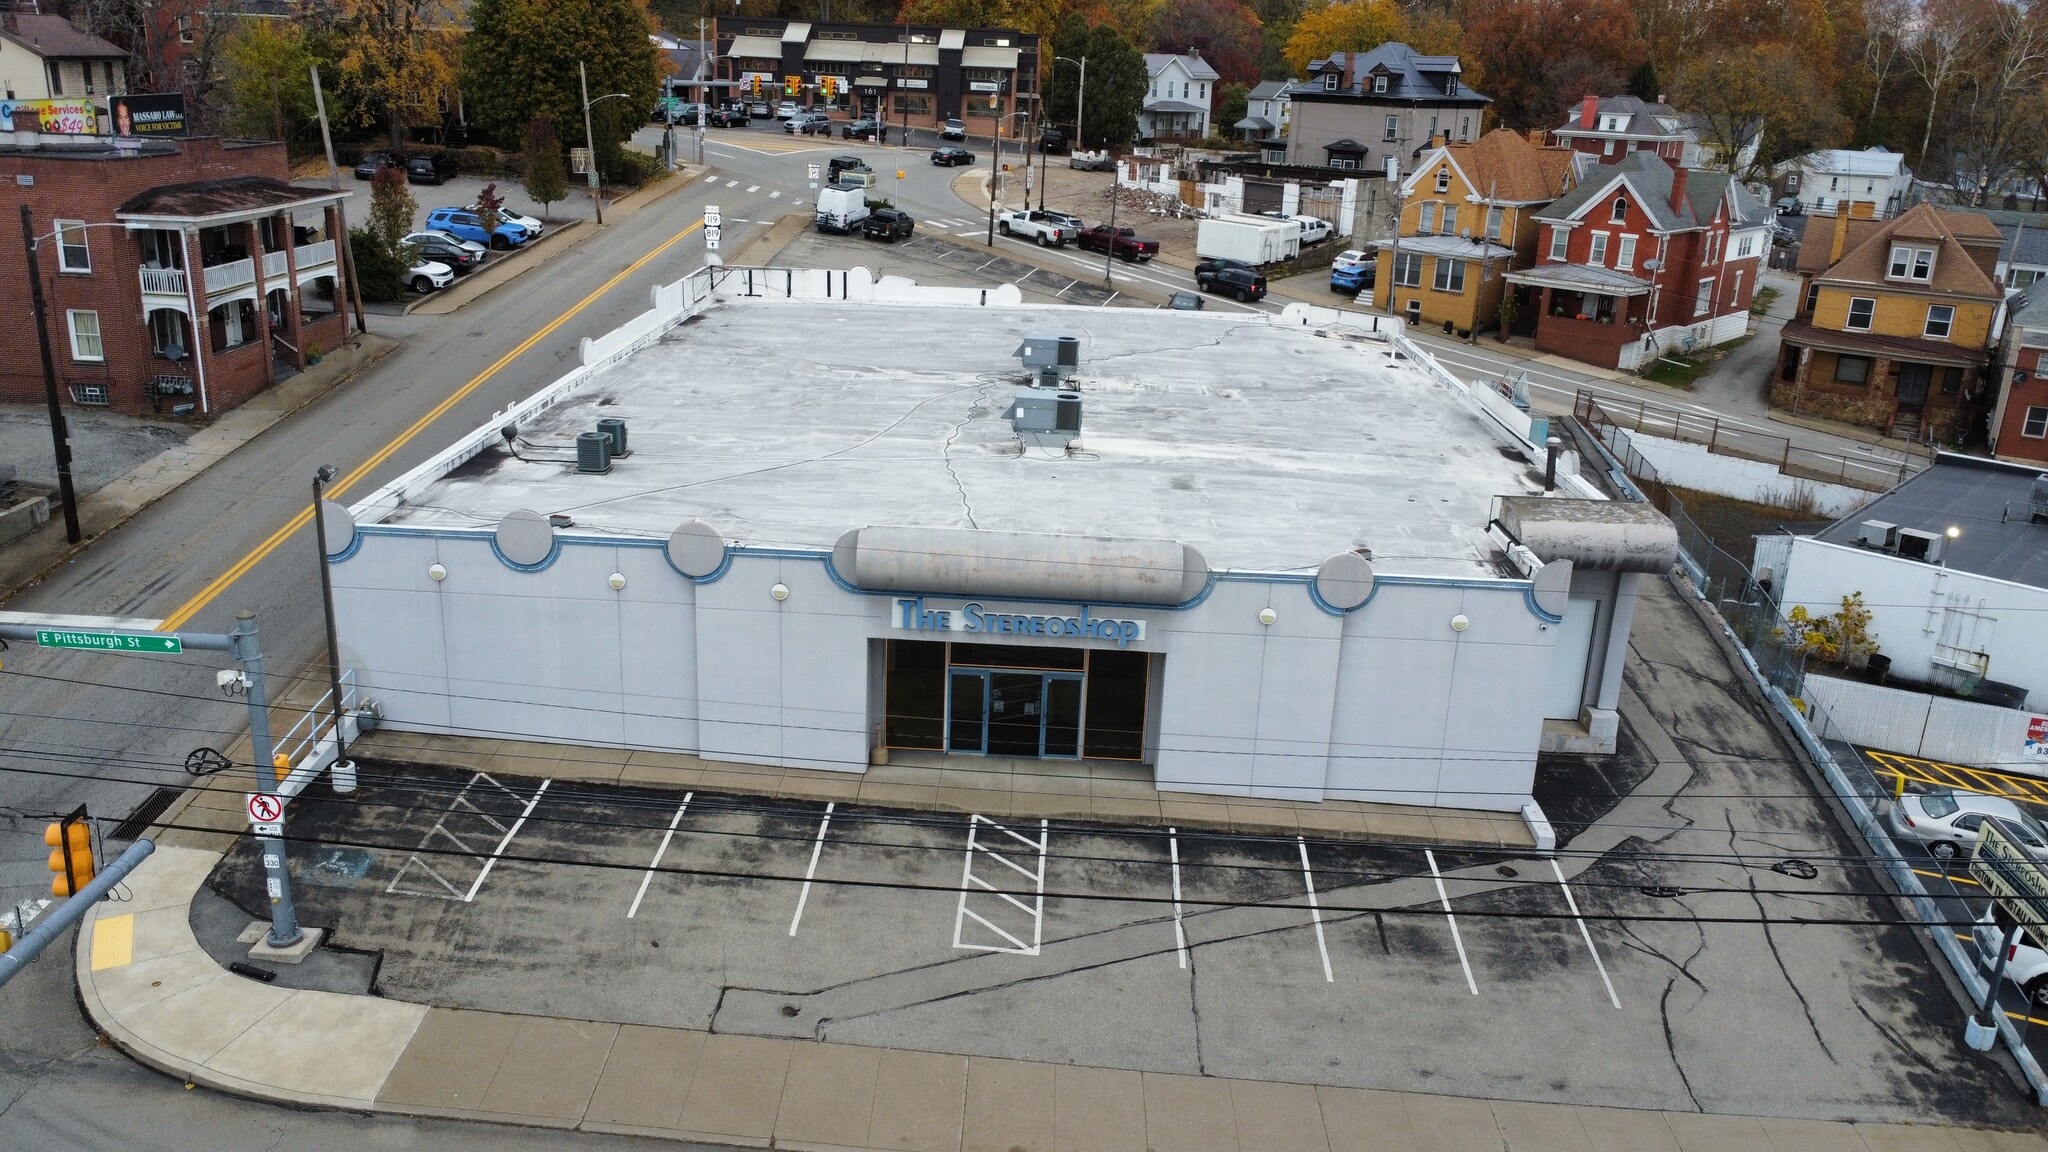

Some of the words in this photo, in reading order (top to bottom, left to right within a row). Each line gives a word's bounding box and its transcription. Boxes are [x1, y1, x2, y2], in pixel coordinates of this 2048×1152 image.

[47, 104, 84, 115] Services
[132, 111, 161, 122] MASSARO
[162, 110, 176, 120] LAW
[58, 117, 84, 133] $49
[135, 124, 152, 132] VOICE
[152, 122, 162, 130] FOR
[162, 121, 183, 130] VICTIMS
[707, 215, 718, 224] 119
[706, 229, 719, 238] 819
[42, 633, 49, 642] E
[54, 633, 122, 648] Pittsburgh
[128, 637, 140, 647] St
[265, 859, 279, 867] 330
[1971, 862, 1994, 891] CUSTOM
[2003, 893, 2048, 947] INSTALLATIONS
